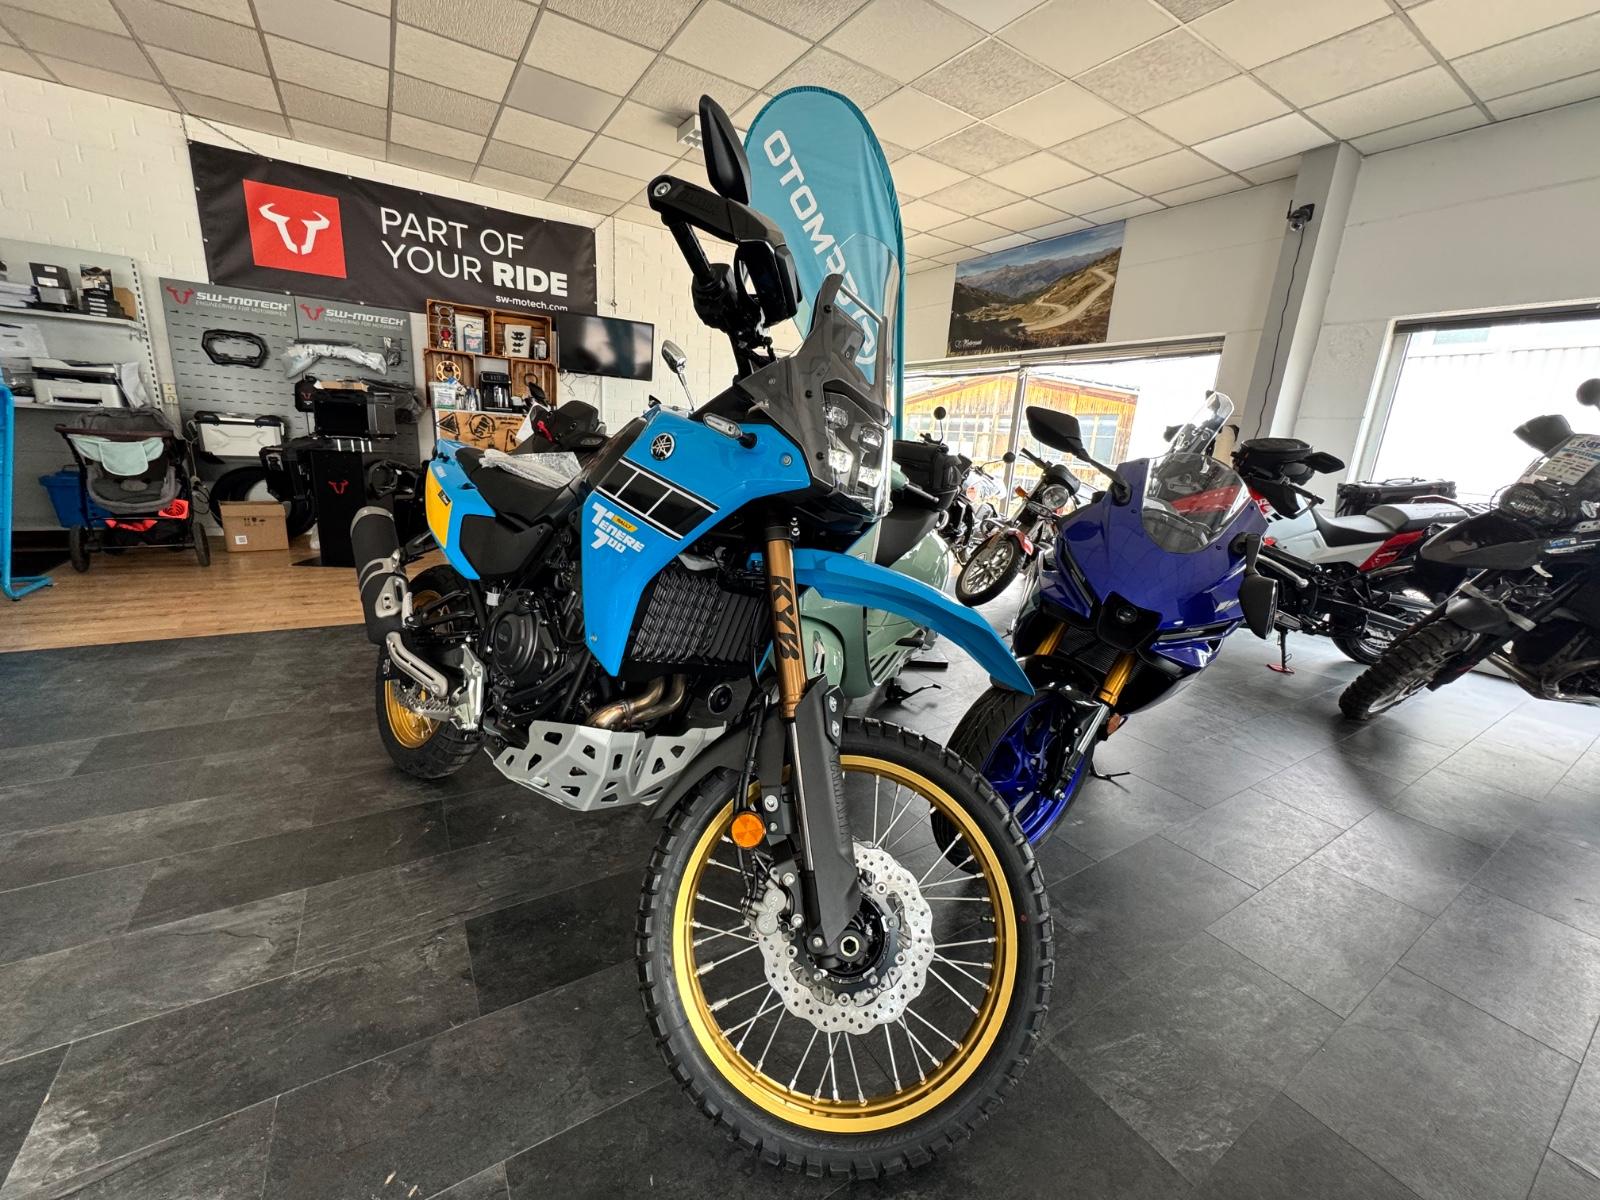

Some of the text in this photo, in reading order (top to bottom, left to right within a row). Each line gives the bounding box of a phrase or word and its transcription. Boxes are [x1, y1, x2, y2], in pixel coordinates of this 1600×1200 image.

[380, 207, 523, 258] PART OF
[381, 240, 568, 297] YOUR RIDE
[196, 292, 289, 311] SW-MOTECH
[495, 295, 568, 312] sw-motech.com
[325, 309, 403, 326] SW-MOTECH
[591, 528, 627, 554] 700
[769, 575, 800, 660] KYB
